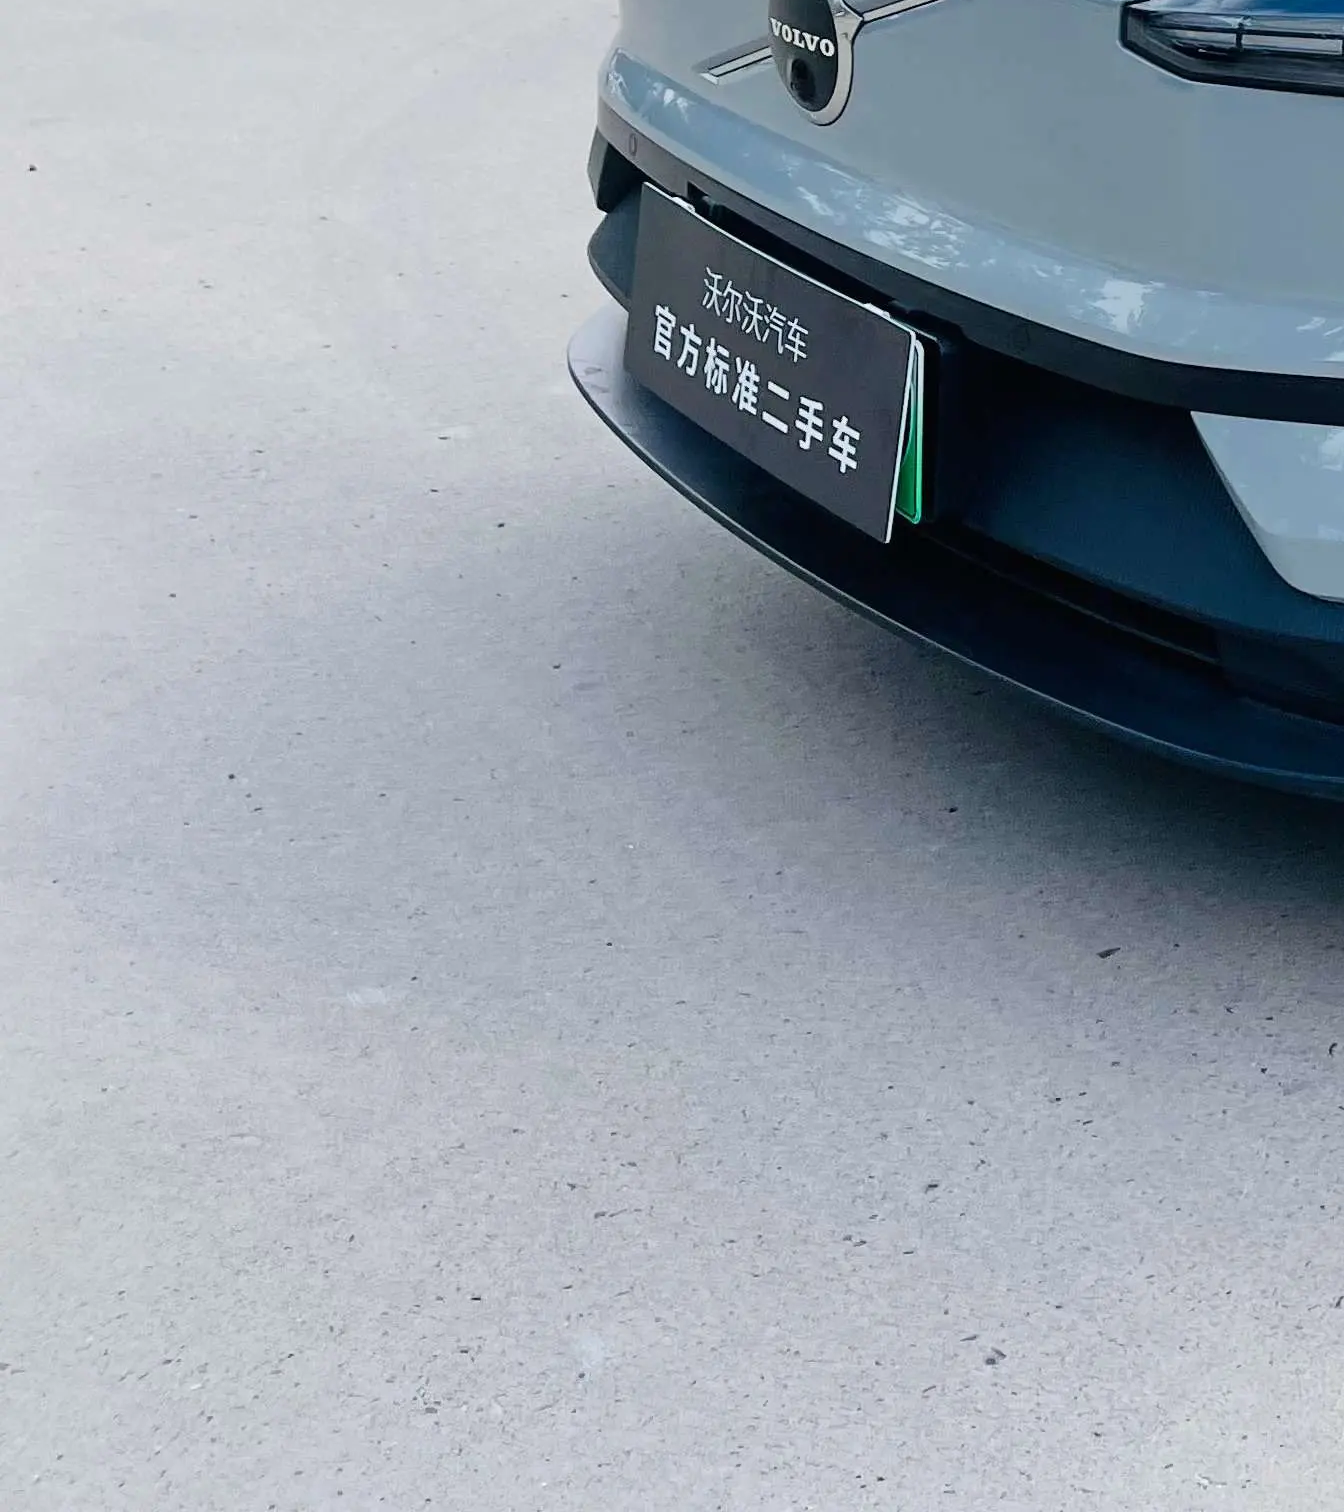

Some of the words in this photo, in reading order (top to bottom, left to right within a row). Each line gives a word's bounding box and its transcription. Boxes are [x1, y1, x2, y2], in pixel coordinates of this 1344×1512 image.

[769, 16, 836, 57] VOLVO
[702, 267, 809, 362] 沃尔沃汽车
[653, 304, 861, 474] 官方标准二手车
